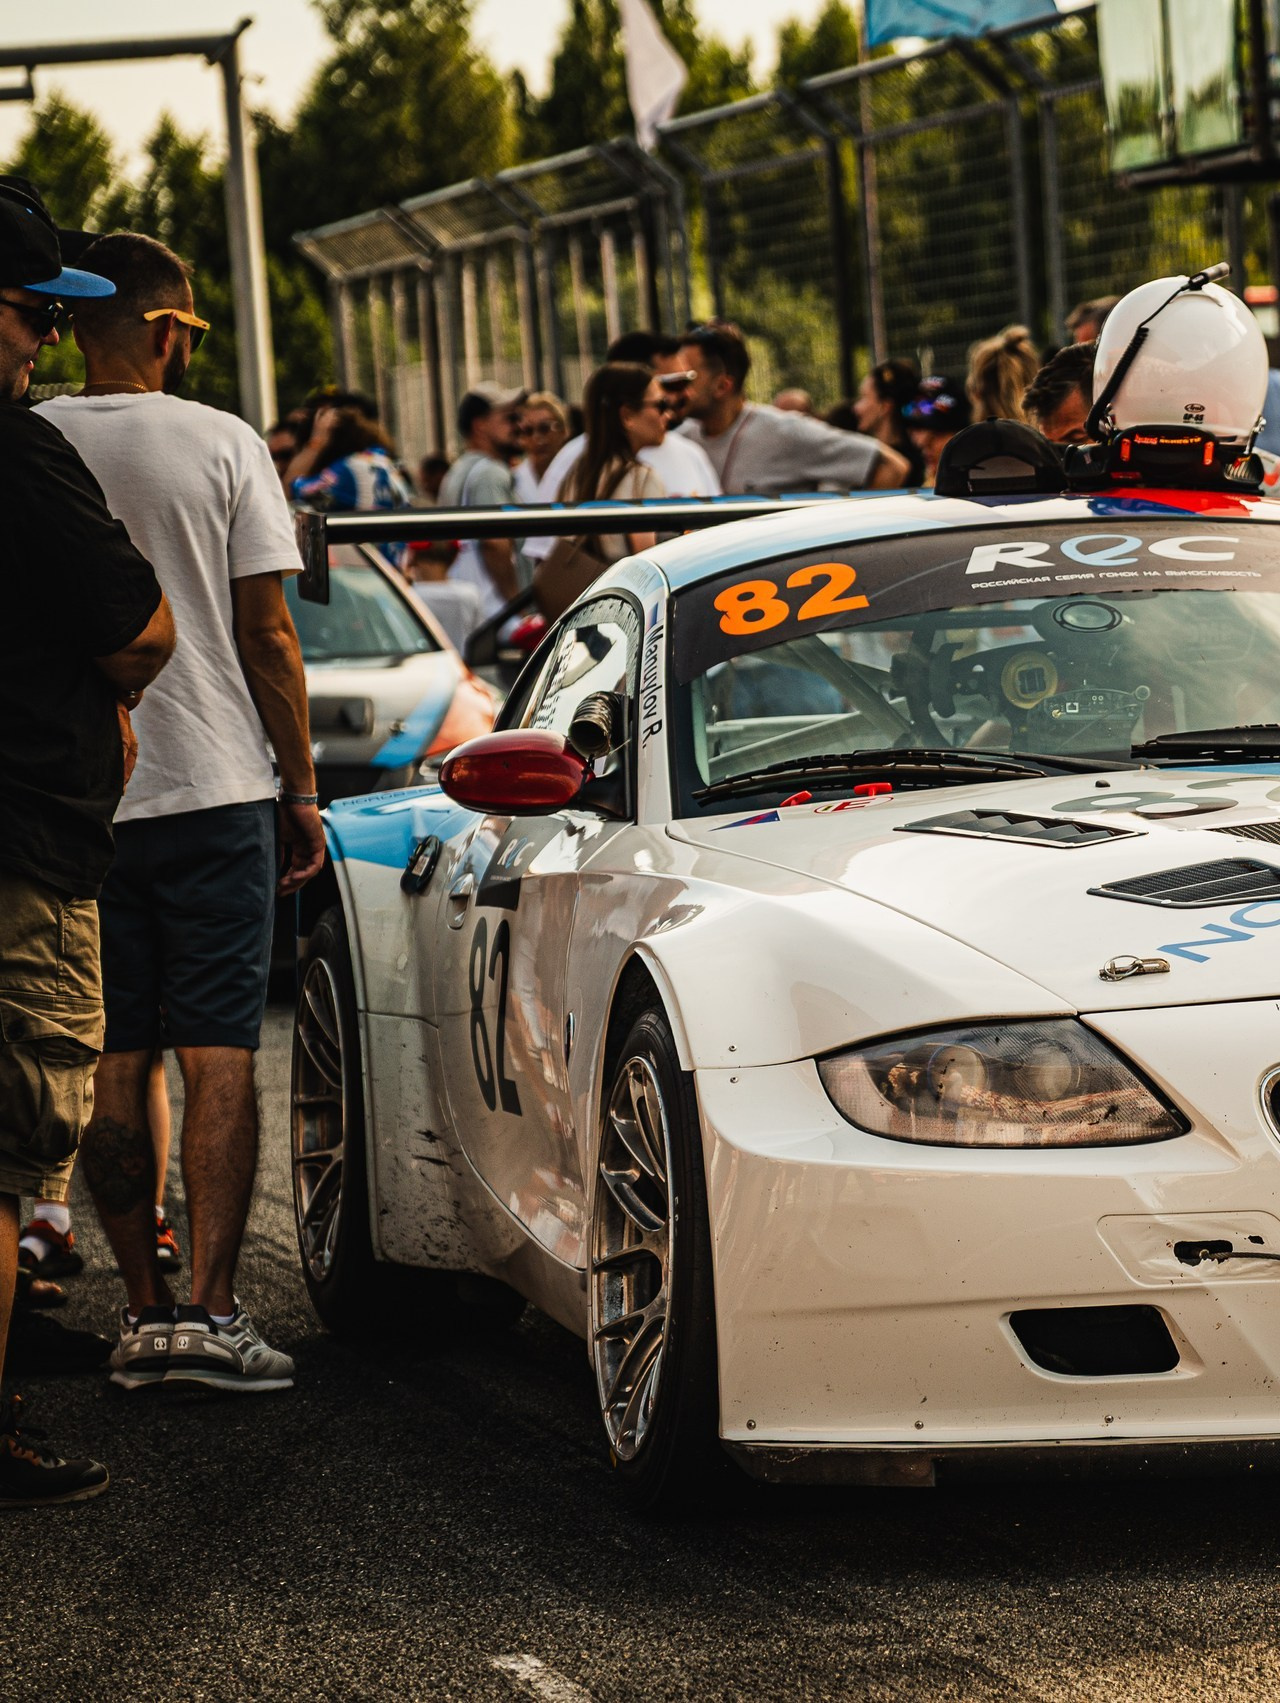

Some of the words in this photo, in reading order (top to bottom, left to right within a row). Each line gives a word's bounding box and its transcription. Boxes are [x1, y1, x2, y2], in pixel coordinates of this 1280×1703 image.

[713, 562, 870, 635] 82
[971, 576, 1050, 589] РОССИЙСКАЯ
[1054, 573, 1095, 582] СЕРИЯ
[1099, 570, 1139, 579] ГОНОК
[1143, 570, 1161, 578] НА
[1165, 569, 1262, 578] ВЫНОСЛИВОСТЬ
[640, 624, 664, 724] Manuylov
[469, 917, 522, 1117] 82
